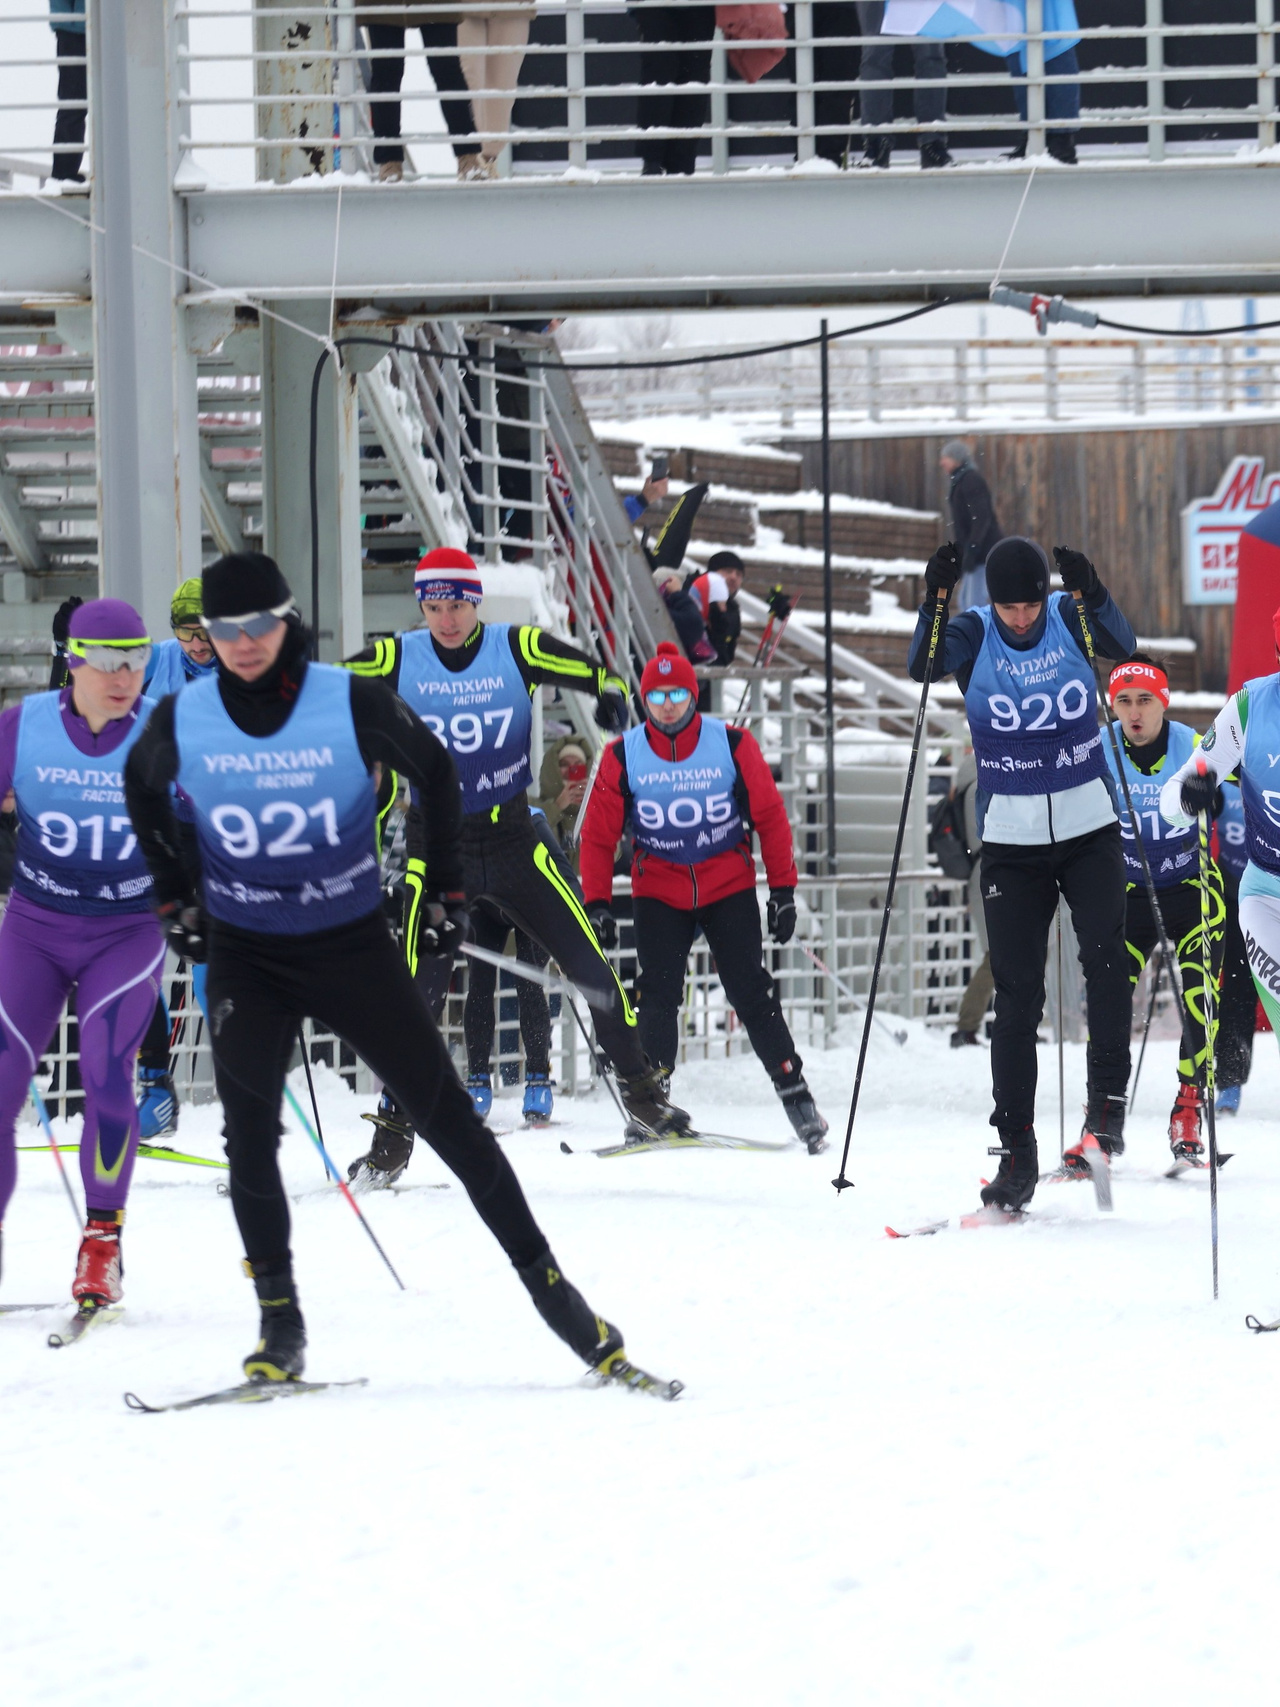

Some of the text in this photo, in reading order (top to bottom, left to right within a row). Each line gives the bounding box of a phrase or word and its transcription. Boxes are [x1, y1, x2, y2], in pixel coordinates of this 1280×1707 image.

[1024, 667, 1059, 686] FACTORY
[1110, 665, 1156, 685] LUKOIL
[417, 676, 504, 695] УРАЛХИМ
[453, 692, 493, 706] FACTORY
[988, 679, 1088, 732] 920
[204, 747, 334, 774] УРАЛХИМ
[981, 758, 1043, 771] Arta Sport
[36, 766, 125, 787] УРАЛХИ
[637, 767, 722, 785] УРАЛХИМ
[82, 789, 125, 803] FACTO
[673, 781, 711, 792] FACTORY
[637, 792, 731, 830] 905
[38, 811, 138, 861] 917
[211, 797, 341, 858] 921
